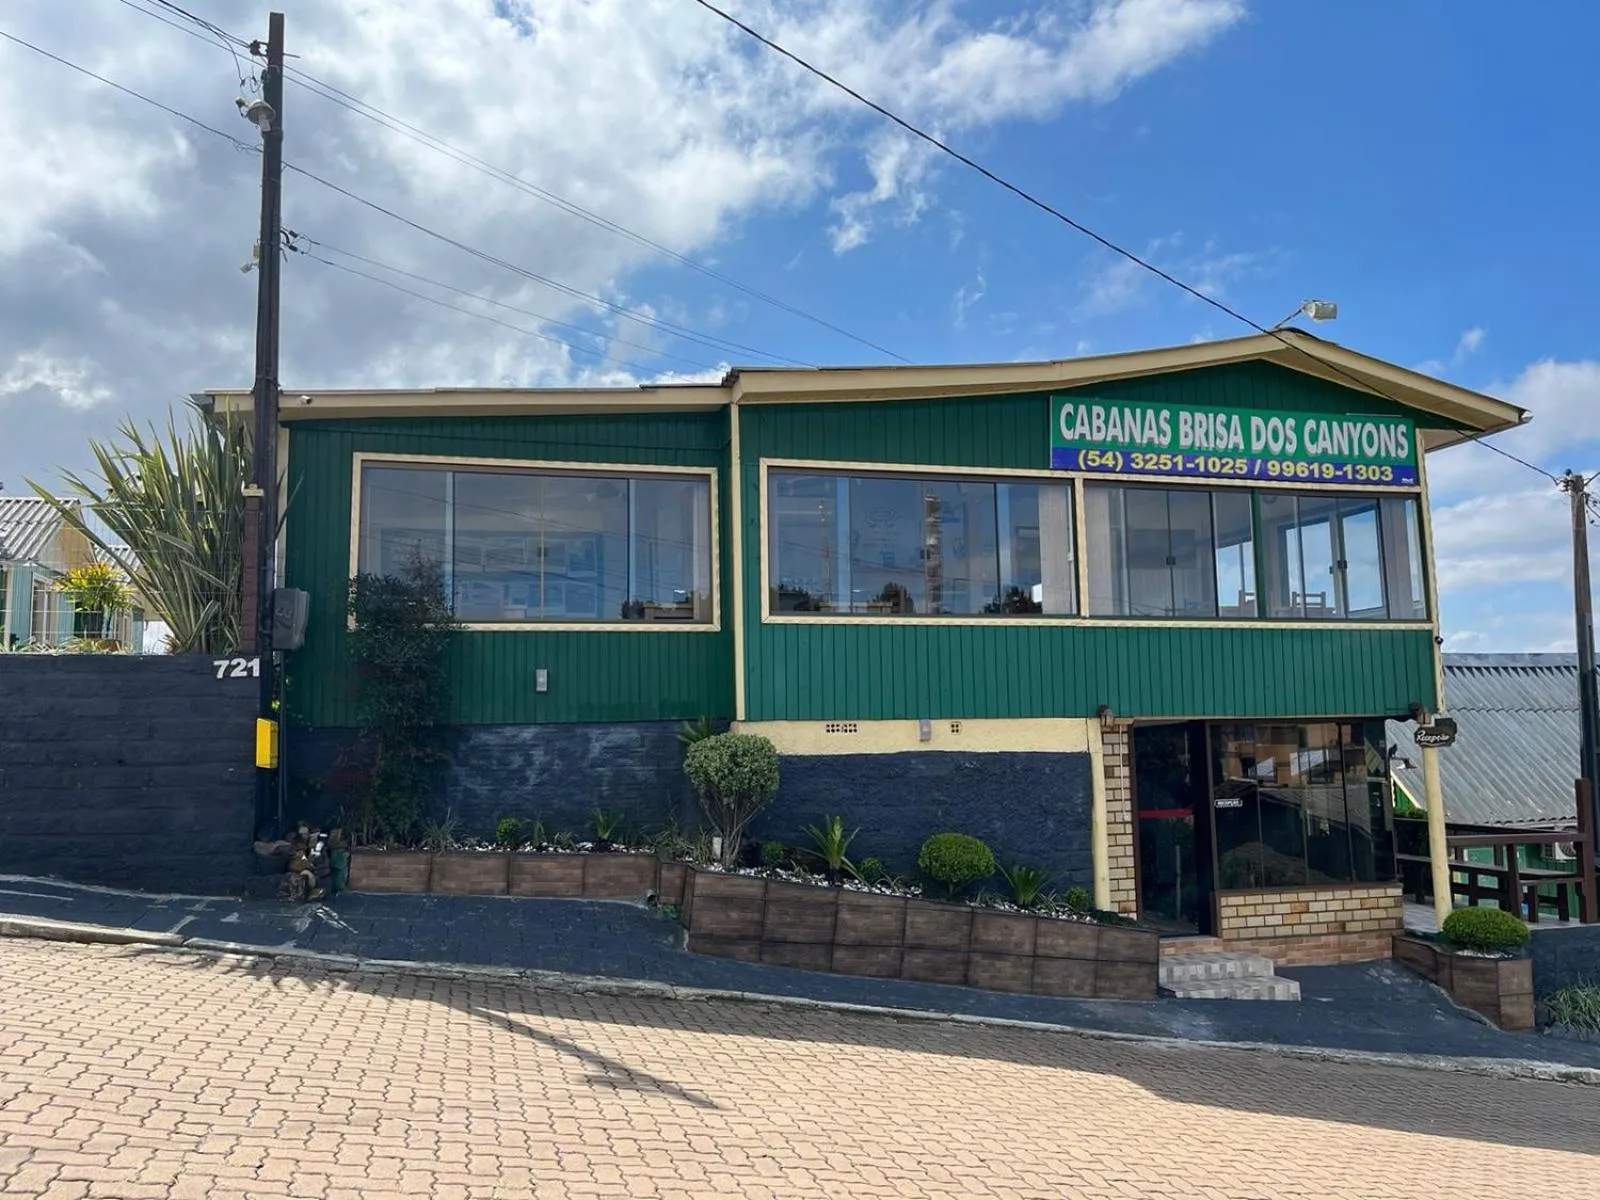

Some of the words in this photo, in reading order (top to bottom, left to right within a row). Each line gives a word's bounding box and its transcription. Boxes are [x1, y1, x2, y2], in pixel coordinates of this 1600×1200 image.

[1060, 402, 1172, 446] CABANAS
[1179, 411, 1245, 451] BRISA
[1250, 415, 1298, 453] DOS
[1303, 419, 1409, 459] CANYONS
[1078, 450, 1123, 472] (54)
[1130, 452, 1248, 474] 3251-1025
[1267, 459, 1394, 481] 99619-1303
[213, 657, 260, 679] 721
